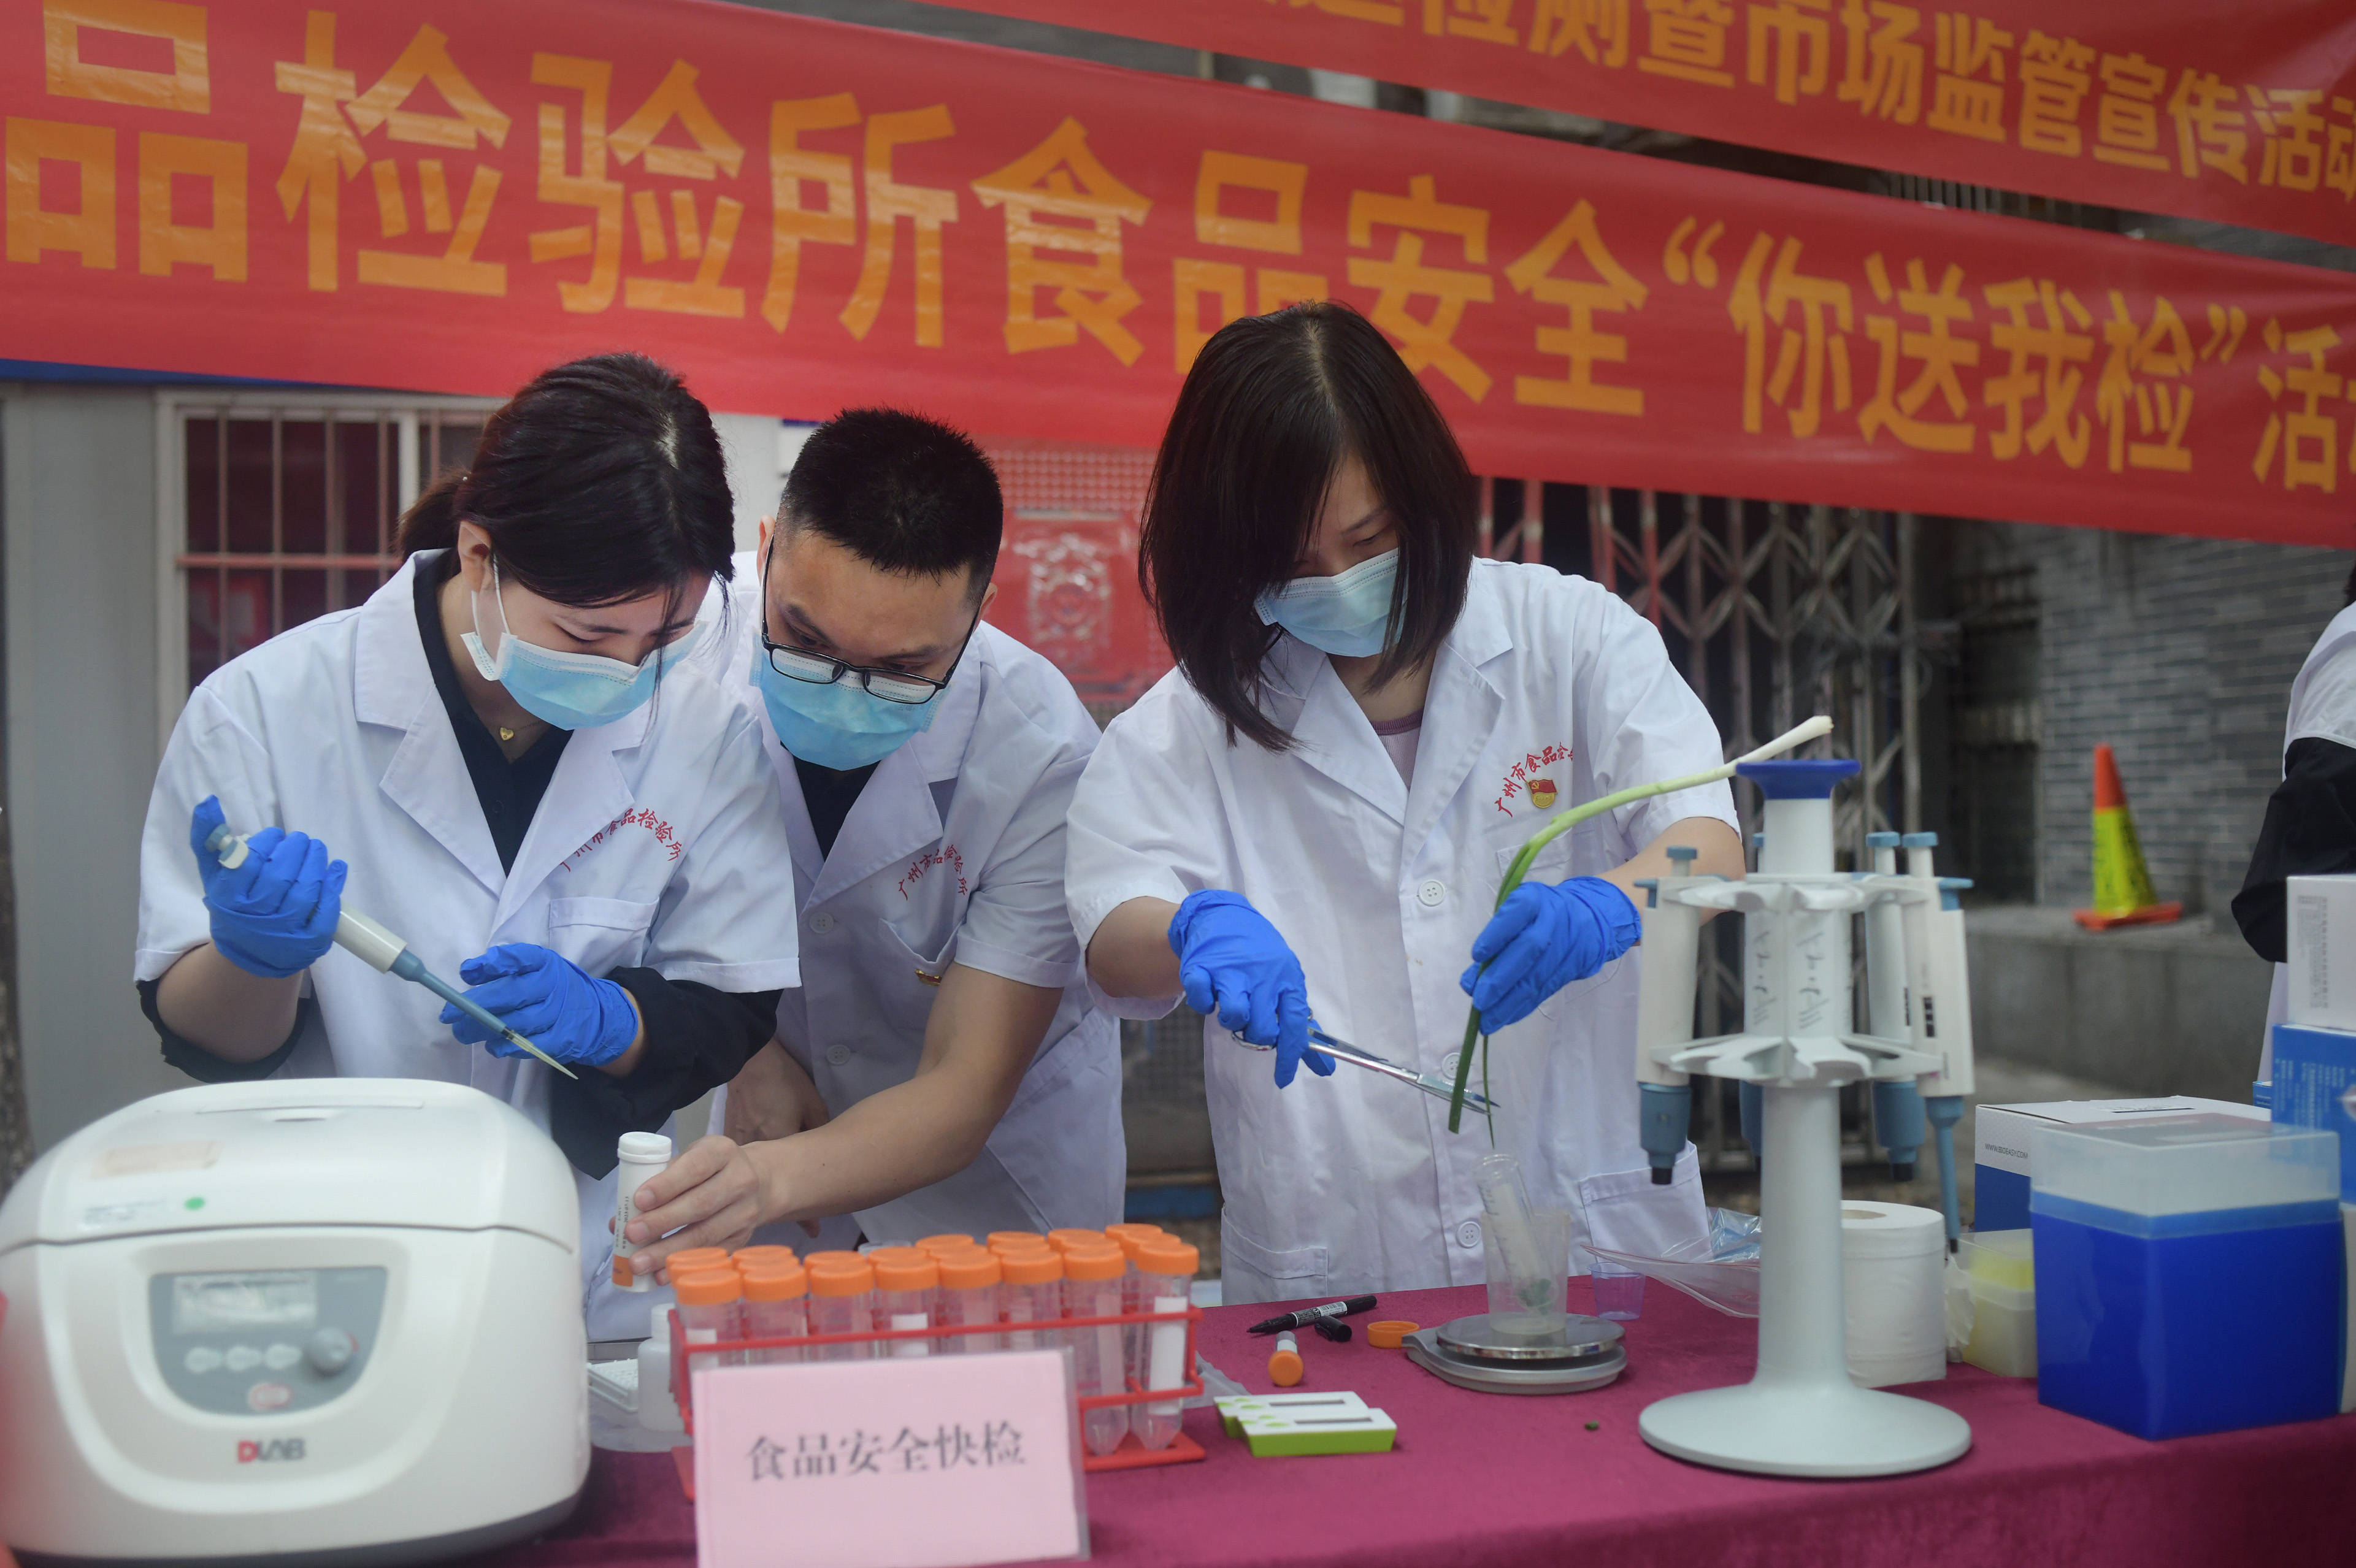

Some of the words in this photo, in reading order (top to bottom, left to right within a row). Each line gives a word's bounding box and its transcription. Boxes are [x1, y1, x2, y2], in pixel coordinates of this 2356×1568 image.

[5, 0, 2356, 493] 品检验所食品安全“你送我检”活
[237, 1438, 305, 1464] DLAB
[747, 1420, 1026, 1481] 食品安全快检
